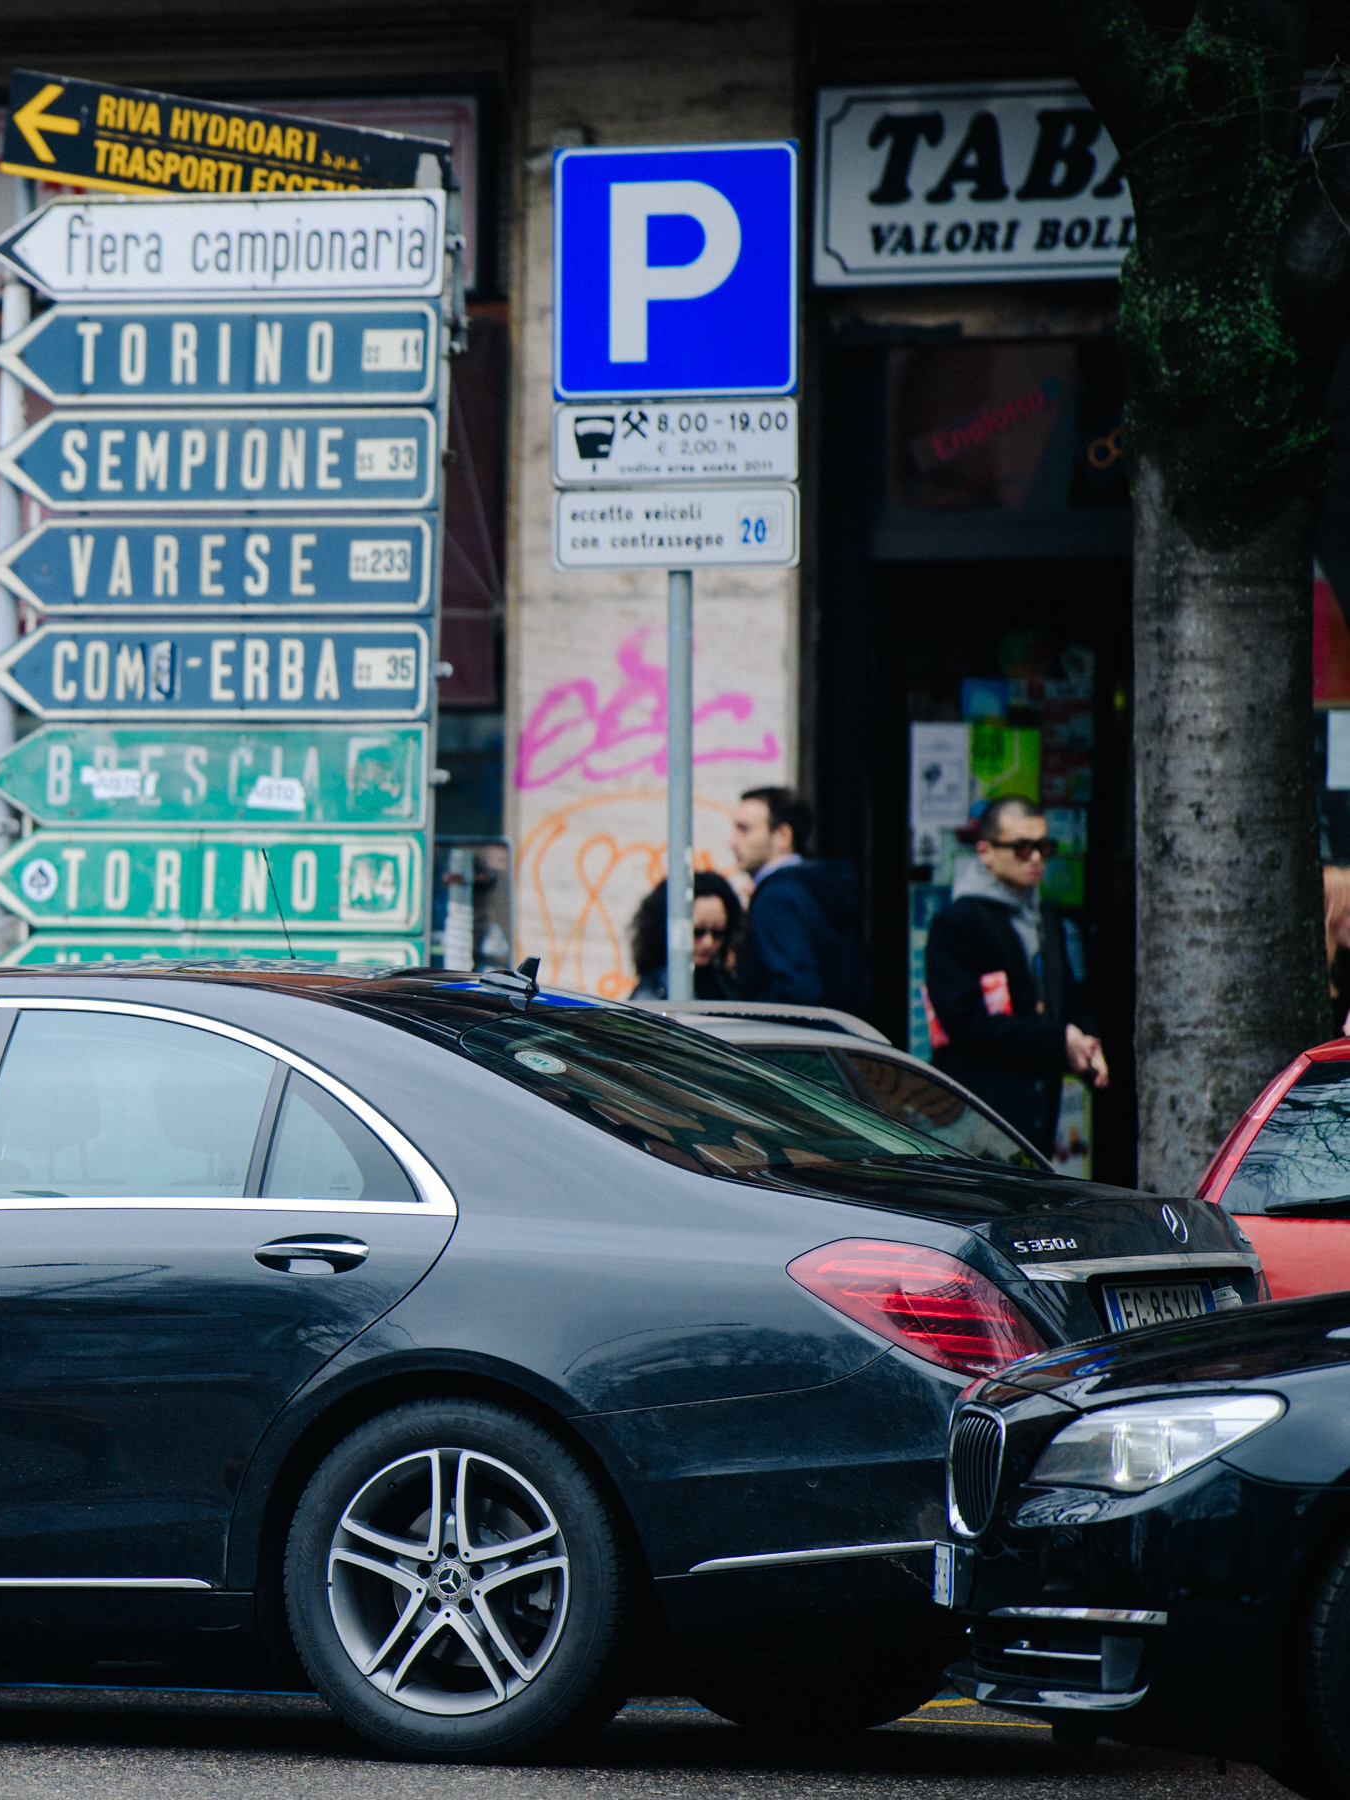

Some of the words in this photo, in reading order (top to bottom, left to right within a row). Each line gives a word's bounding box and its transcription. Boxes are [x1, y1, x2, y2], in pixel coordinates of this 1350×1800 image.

[96, 93, 161, 136] RIVA
[94, 139, 244, 192] TRASPORTI
[866, 108, 1131, 206] TAB
[66, 213, 163, 275] fiera
[191, 216, 426, 282] campionaria
[868, 218, 1021, 255] VALORI
[609, 179, 742, 364] P
[76, 320, 333, 386] TORINO
[59, 426, 344, 492] SEMPIONE
[388, 445, 415, 471] 33
[571, 505, 633, 521] eccetto
[644, 503, 702, 520] veicoli
[571, 536, 599, 548] con
[611, 532, 724, 550] contrassegno
[741, 517, 767, 544] 20
[68, 533, 318, 598] VARESE
[387, 654, 412, 682] 35
[62, 848, 318, 913] TORINO
[352, 859, 397, 903] A4
